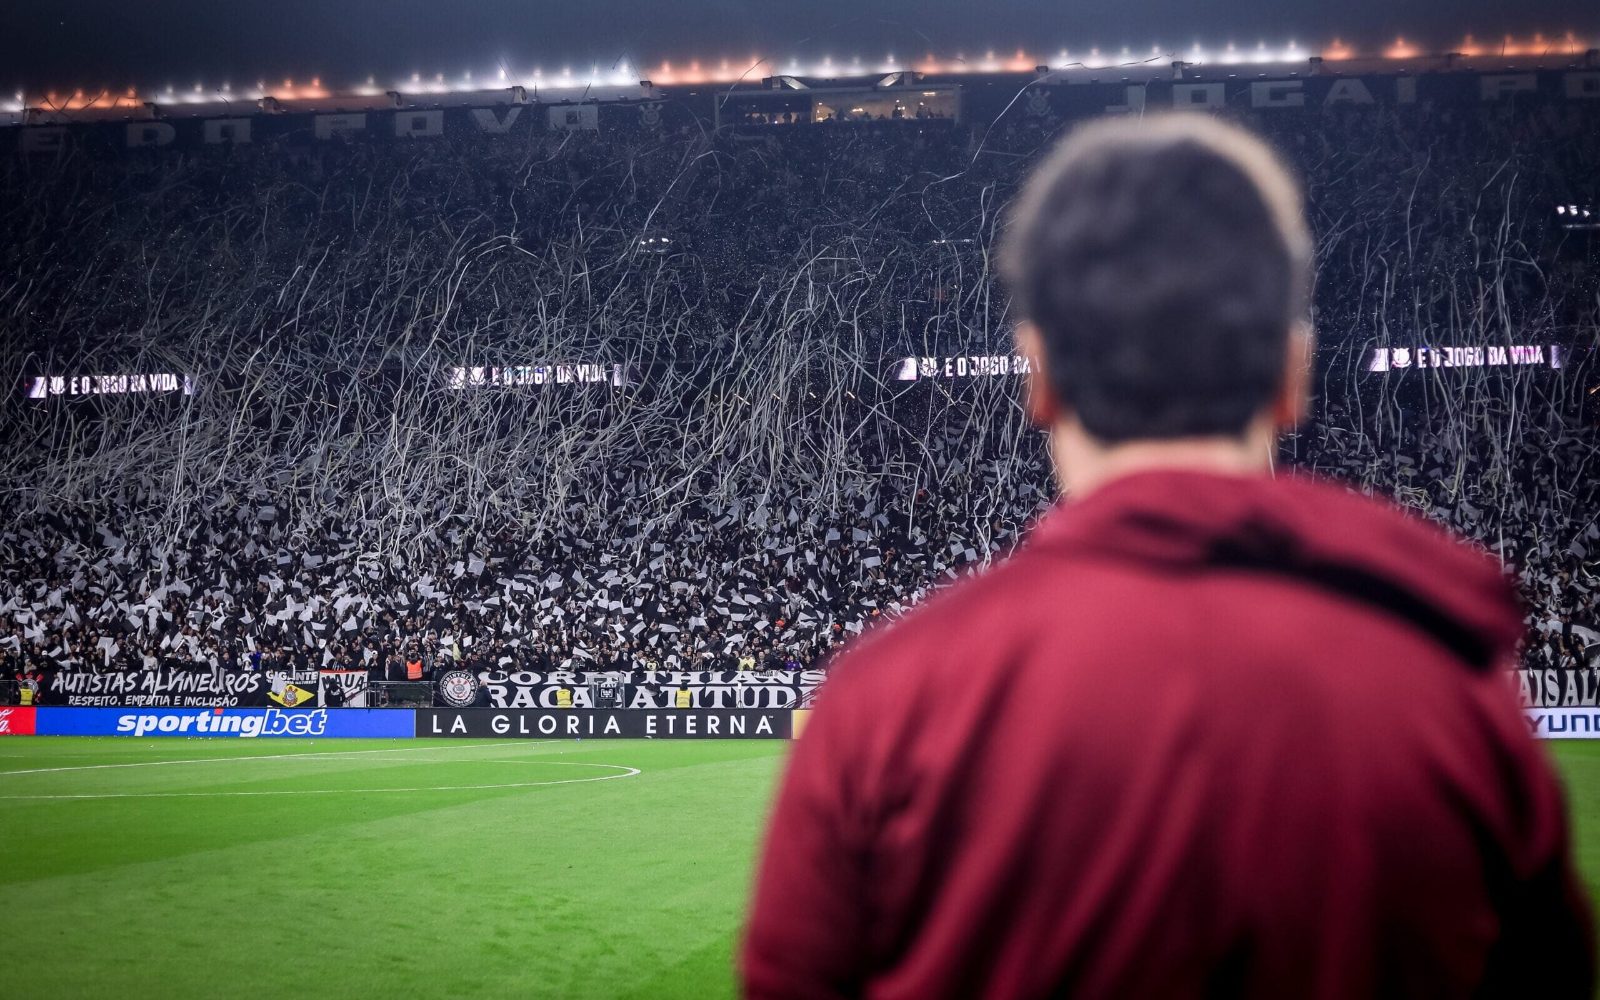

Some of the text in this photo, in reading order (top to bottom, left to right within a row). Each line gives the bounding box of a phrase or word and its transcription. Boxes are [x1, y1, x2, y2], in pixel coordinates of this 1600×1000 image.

[1105, 76, 1416, 113] JOGAI
[314, 105, 599, 139] POVO
[1443, 346, 1485, 367] JOGO
[1487, 346, 1508, 365] DA
[1509, 345, 1545, 364] VIDA
[149, 373, 178, 391] VIDA
[50, 671, 138, 694] AUTISTAS
[173, 695, 181, 706] E
[184, 694, 238, 707] INCLUSÃO
[116, 708, 328, 737] sportingbet
[432, 715, 467, 734] LA
[491, 715, 621, 734] GLORIA
